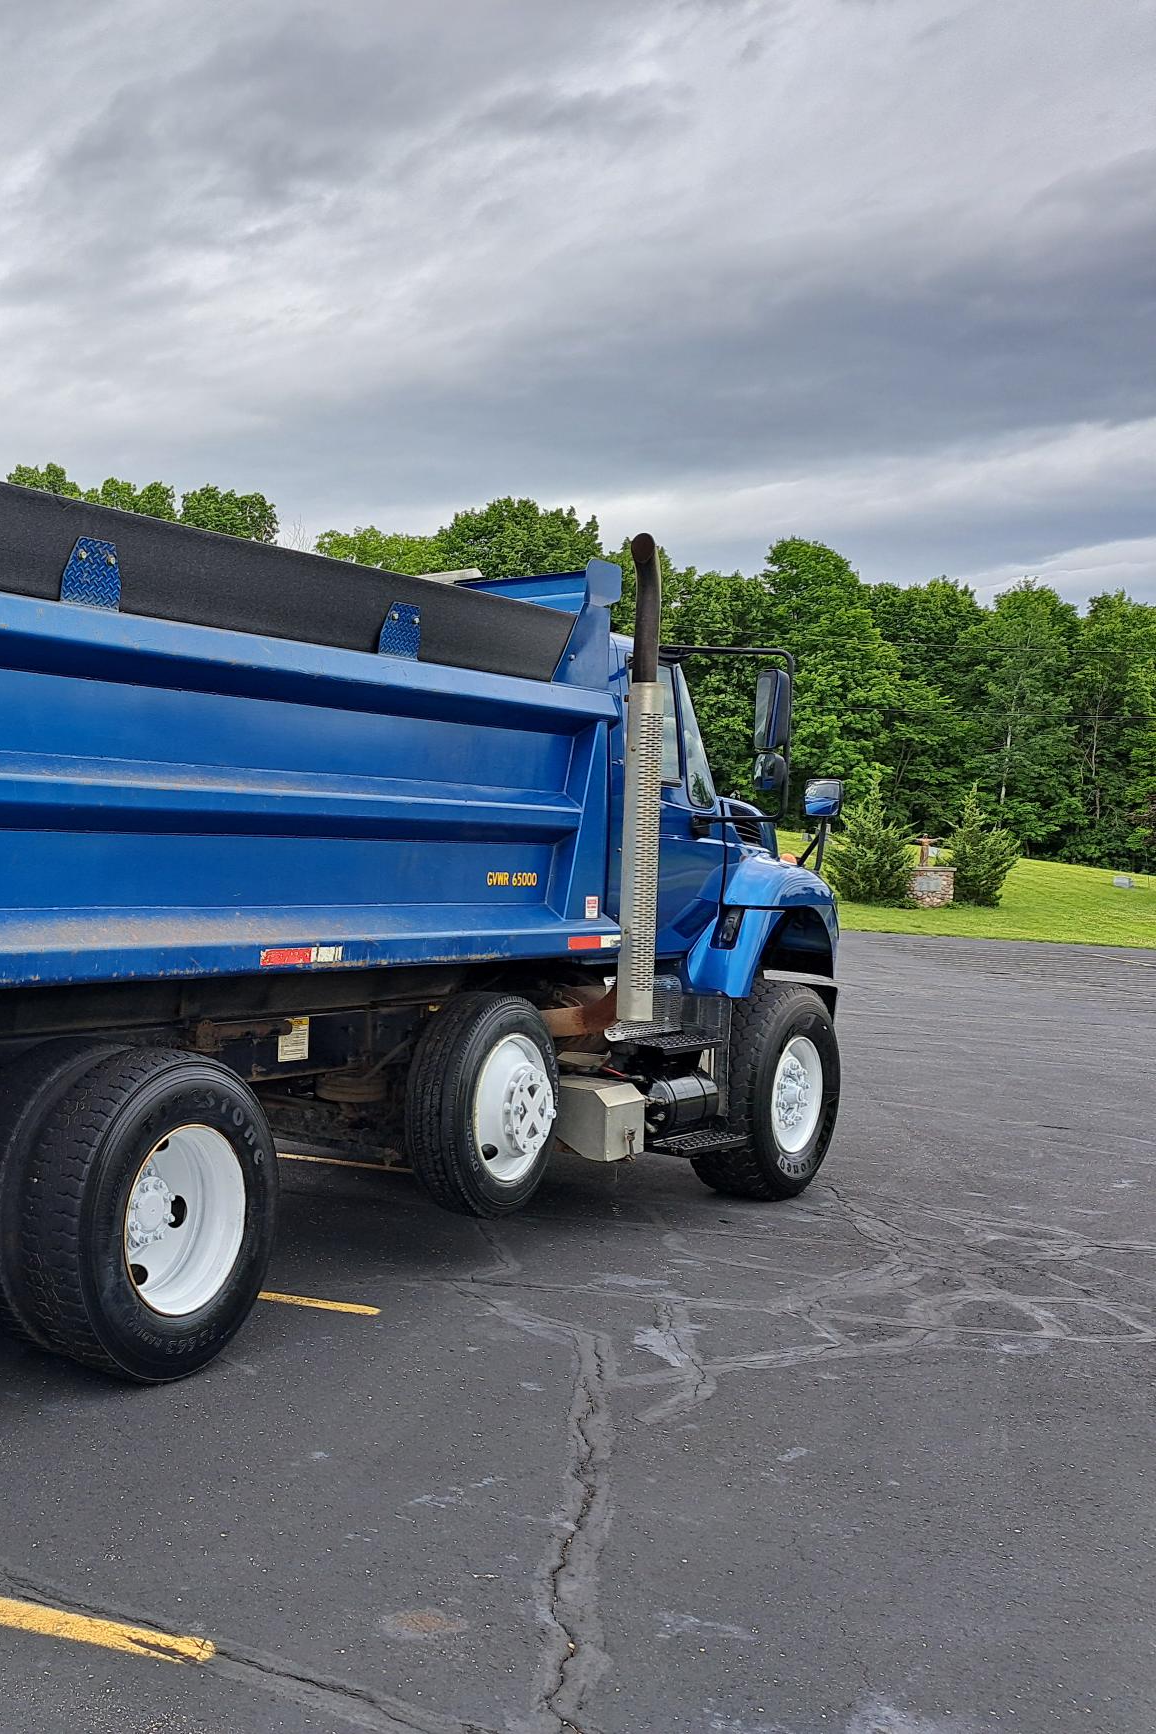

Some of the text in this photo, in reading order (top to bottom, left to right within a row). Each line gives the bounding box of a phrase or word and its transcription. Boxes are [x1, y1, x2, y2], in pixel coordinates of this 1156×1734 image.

[487, 871, 537, 886] GVWR 65000
[545, 1043, 560, 1107] DAYTON
